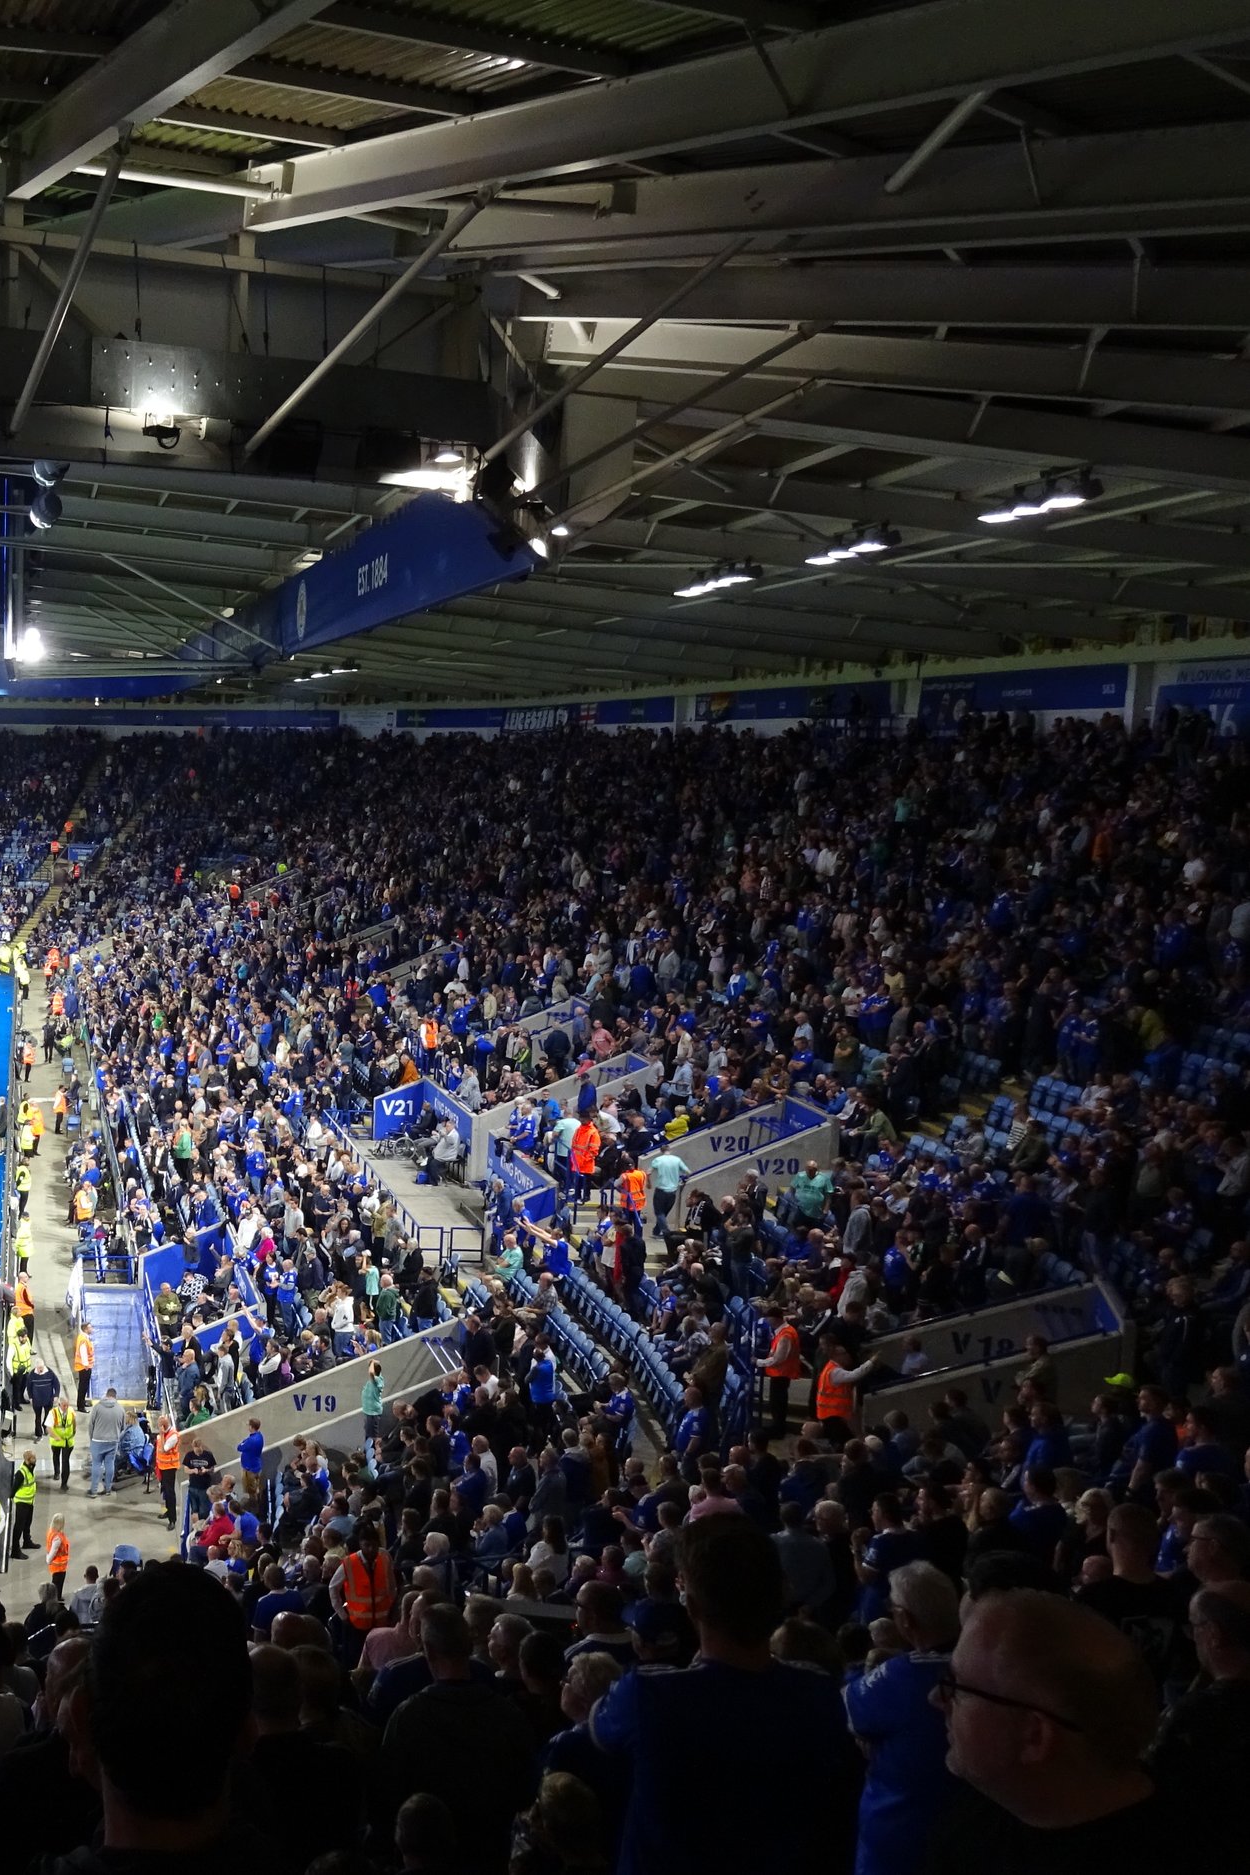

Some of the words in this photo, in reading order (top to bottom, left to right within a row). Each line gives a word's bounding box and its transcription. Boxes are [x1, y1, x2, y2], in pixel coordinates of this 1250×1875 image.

[357, 564, 370, 597] EST.
[371, 552, 389, 591] 1884
[1209, 703, 1238, 737] 16
[381, 1099, 414, 1116] V21
[709, 1136, 750, 1152] V20
[514, 1165, 534, 1190] POWER
[756, 1158, 800, 1176] V20
